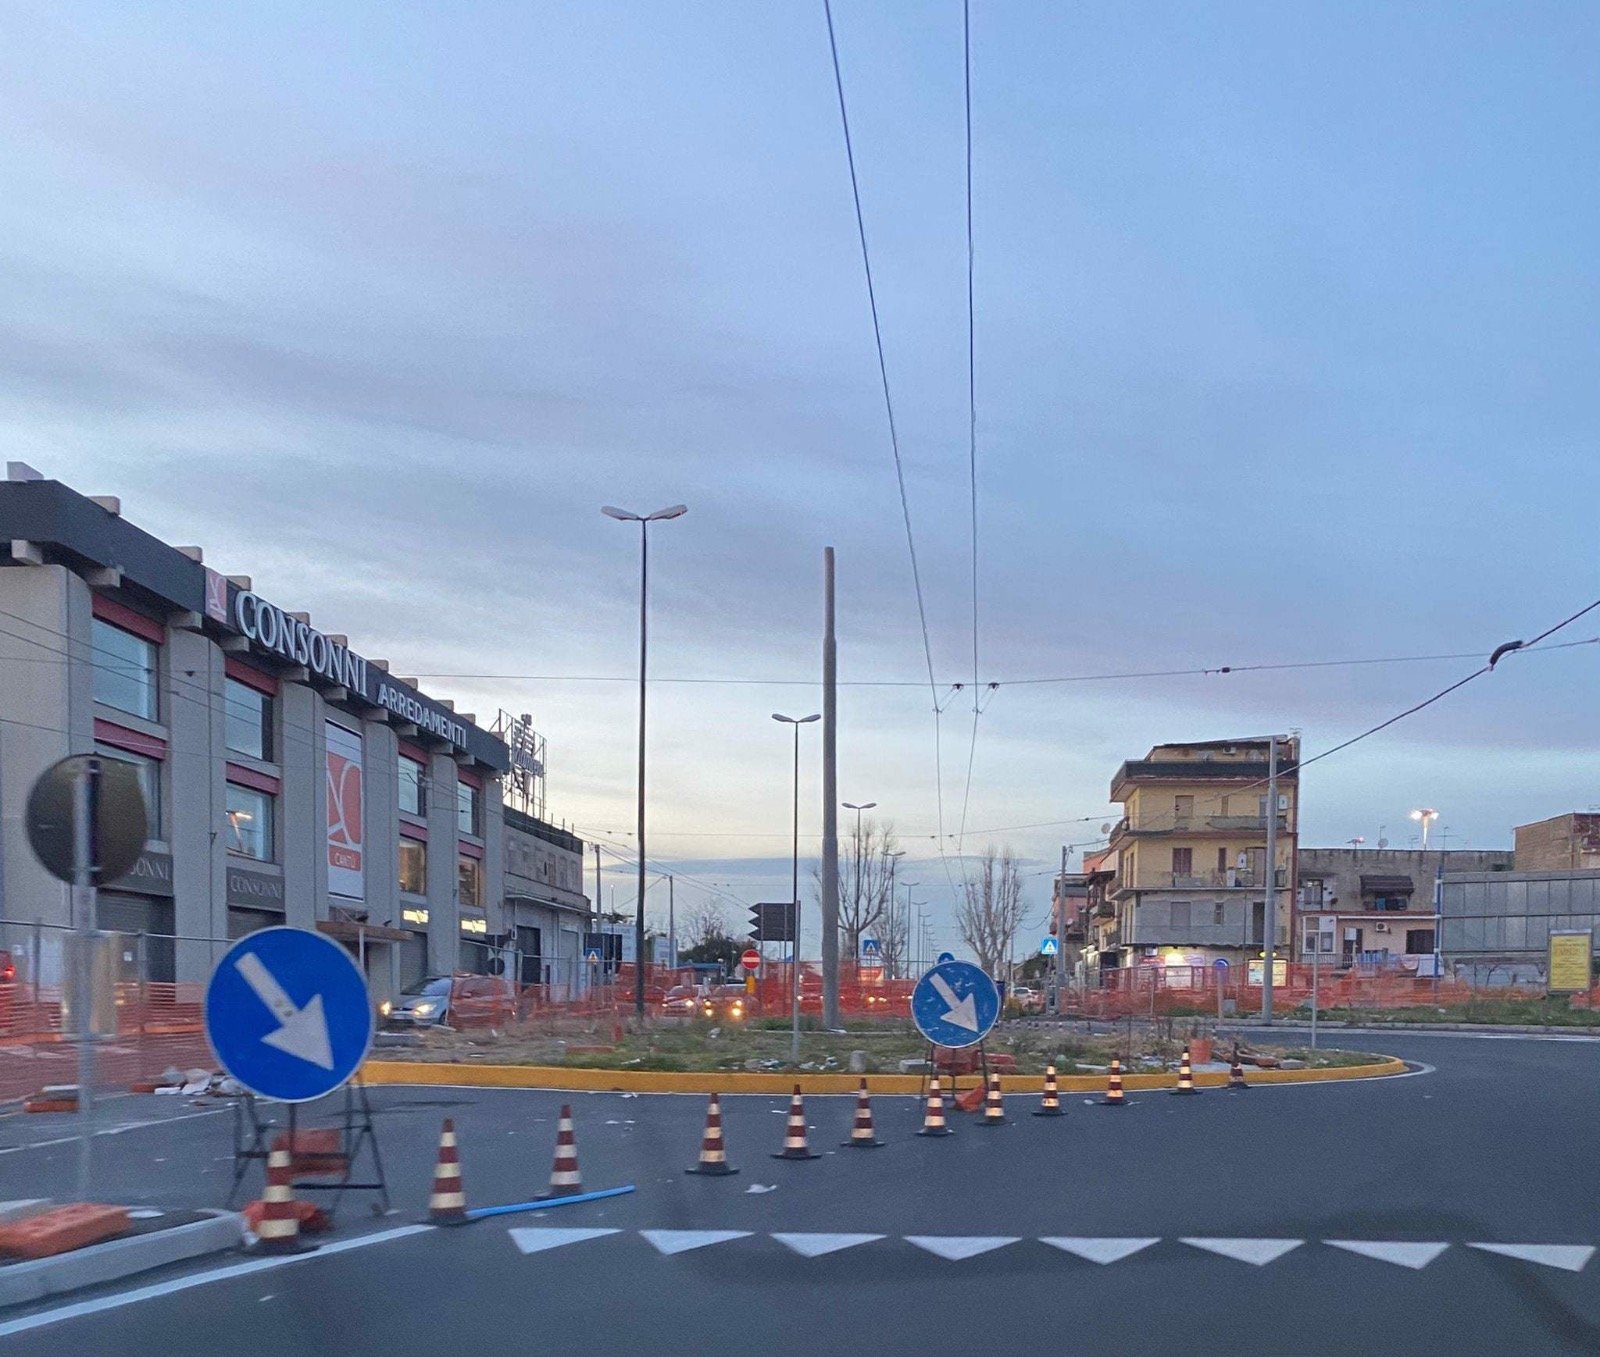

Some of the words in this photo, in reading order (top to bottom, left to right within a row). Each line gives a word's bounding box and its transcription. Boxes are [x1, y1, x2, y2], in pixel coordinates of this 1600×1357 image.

[235, 590, 367, 697] CONSONNI
[377, 683, 468, 748] ARREDAMENTI
[230, 875, 282, 899] CONSONNI
